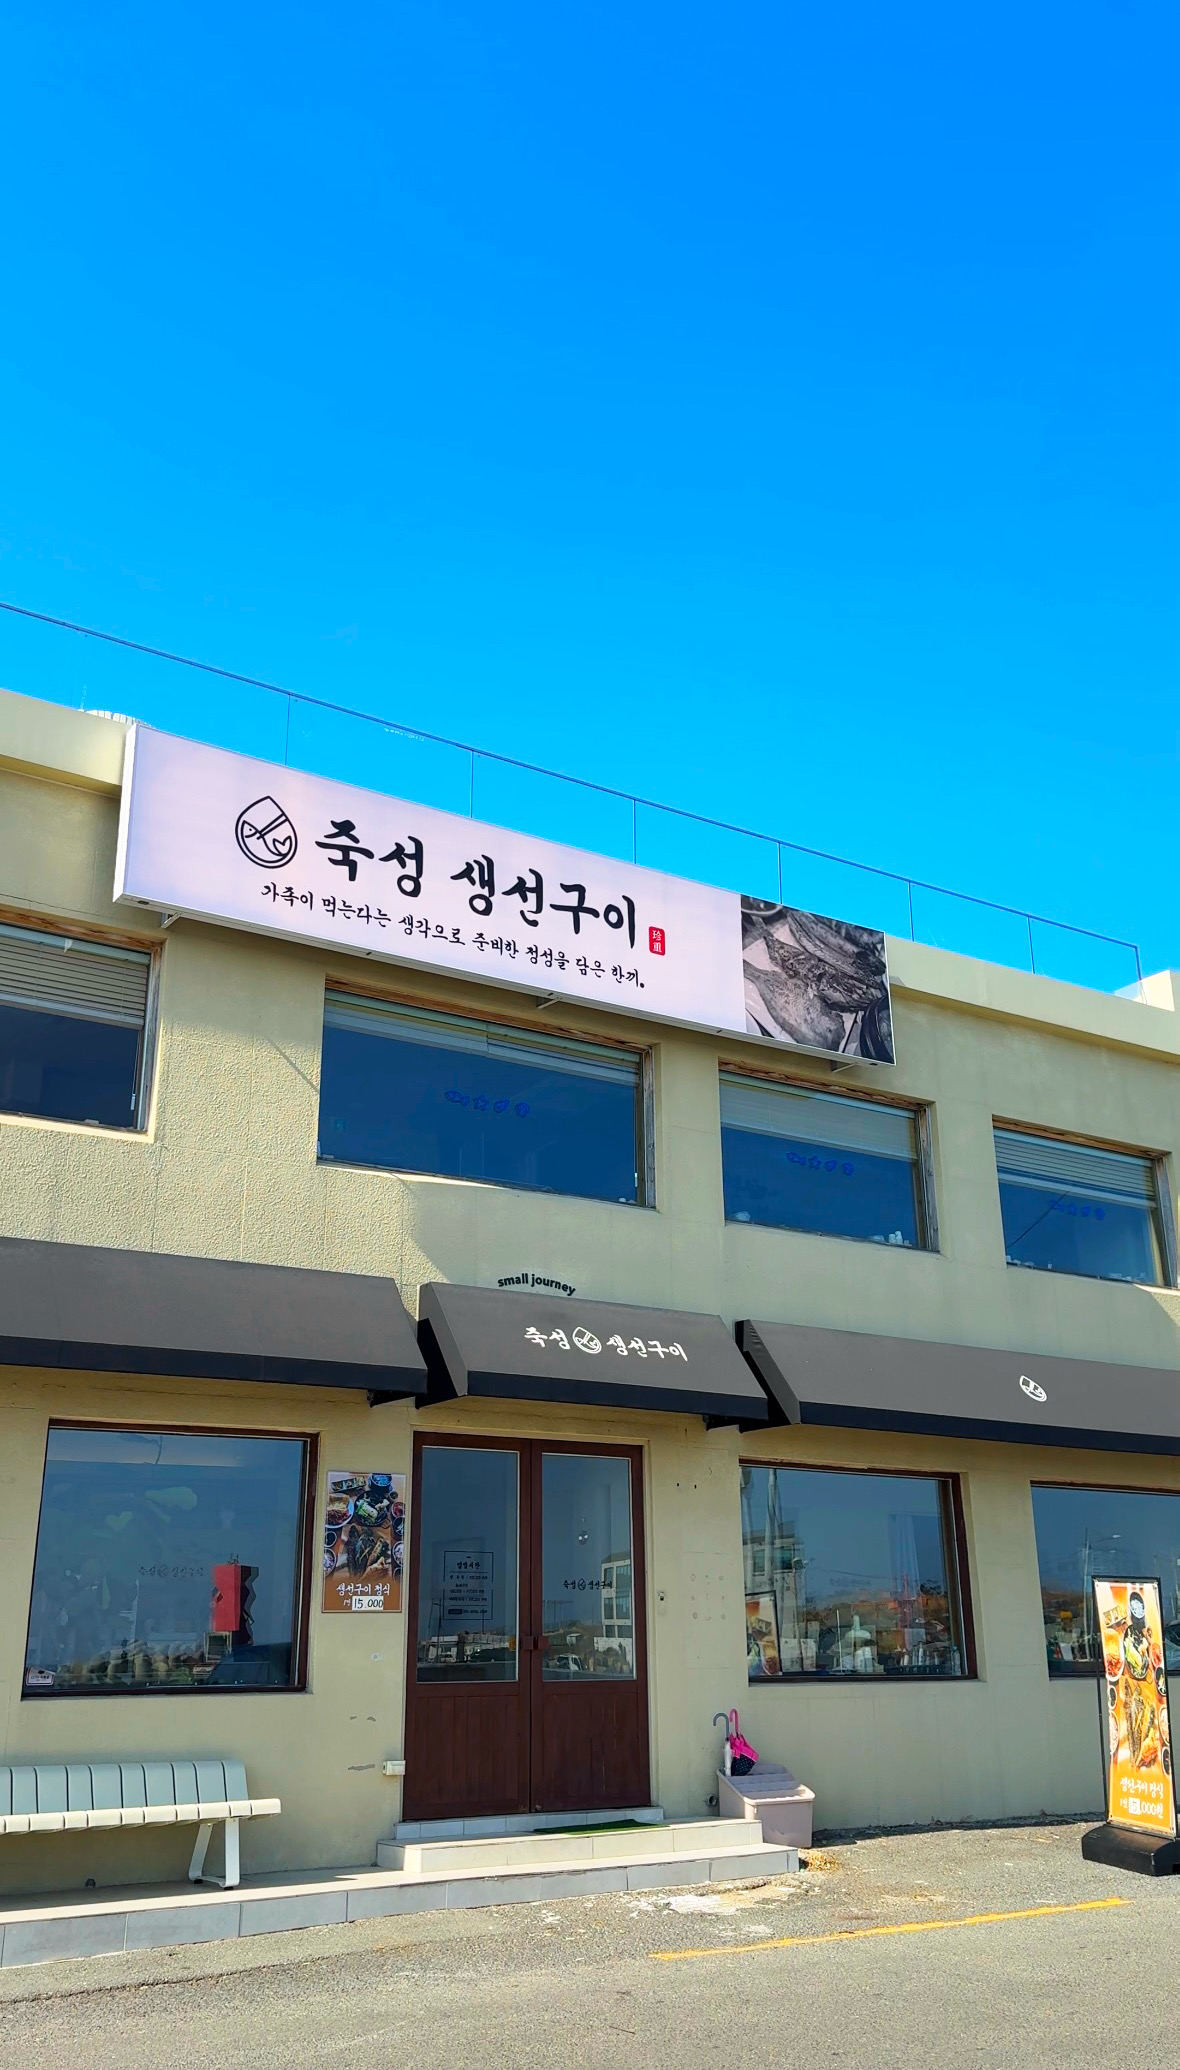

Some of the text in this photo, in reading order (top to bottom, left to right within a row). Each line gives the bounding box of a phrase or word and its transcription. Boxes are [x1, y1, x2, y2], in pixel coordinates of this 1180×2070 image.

[315, 819, 636, 949] 죽성 생선구이
[261, 881, 314, 911] 가족이
[321, 895, 391, 928] 먹는다는
[398, 914, 466, 946] 생각으로
[472, 932, 519, 959] 준비한
[525, 944, 570, 971] 정성을
[575, 955, 606, 978] 담은
[497, 1272, 577, 1297] small journey
[524, 1326, 688, 1362] 죽성 생선구이
[336, 1582, 390, 1597] 생선구이 정식
[1120, 1776, 1164, 1800] 생선구이 정식
